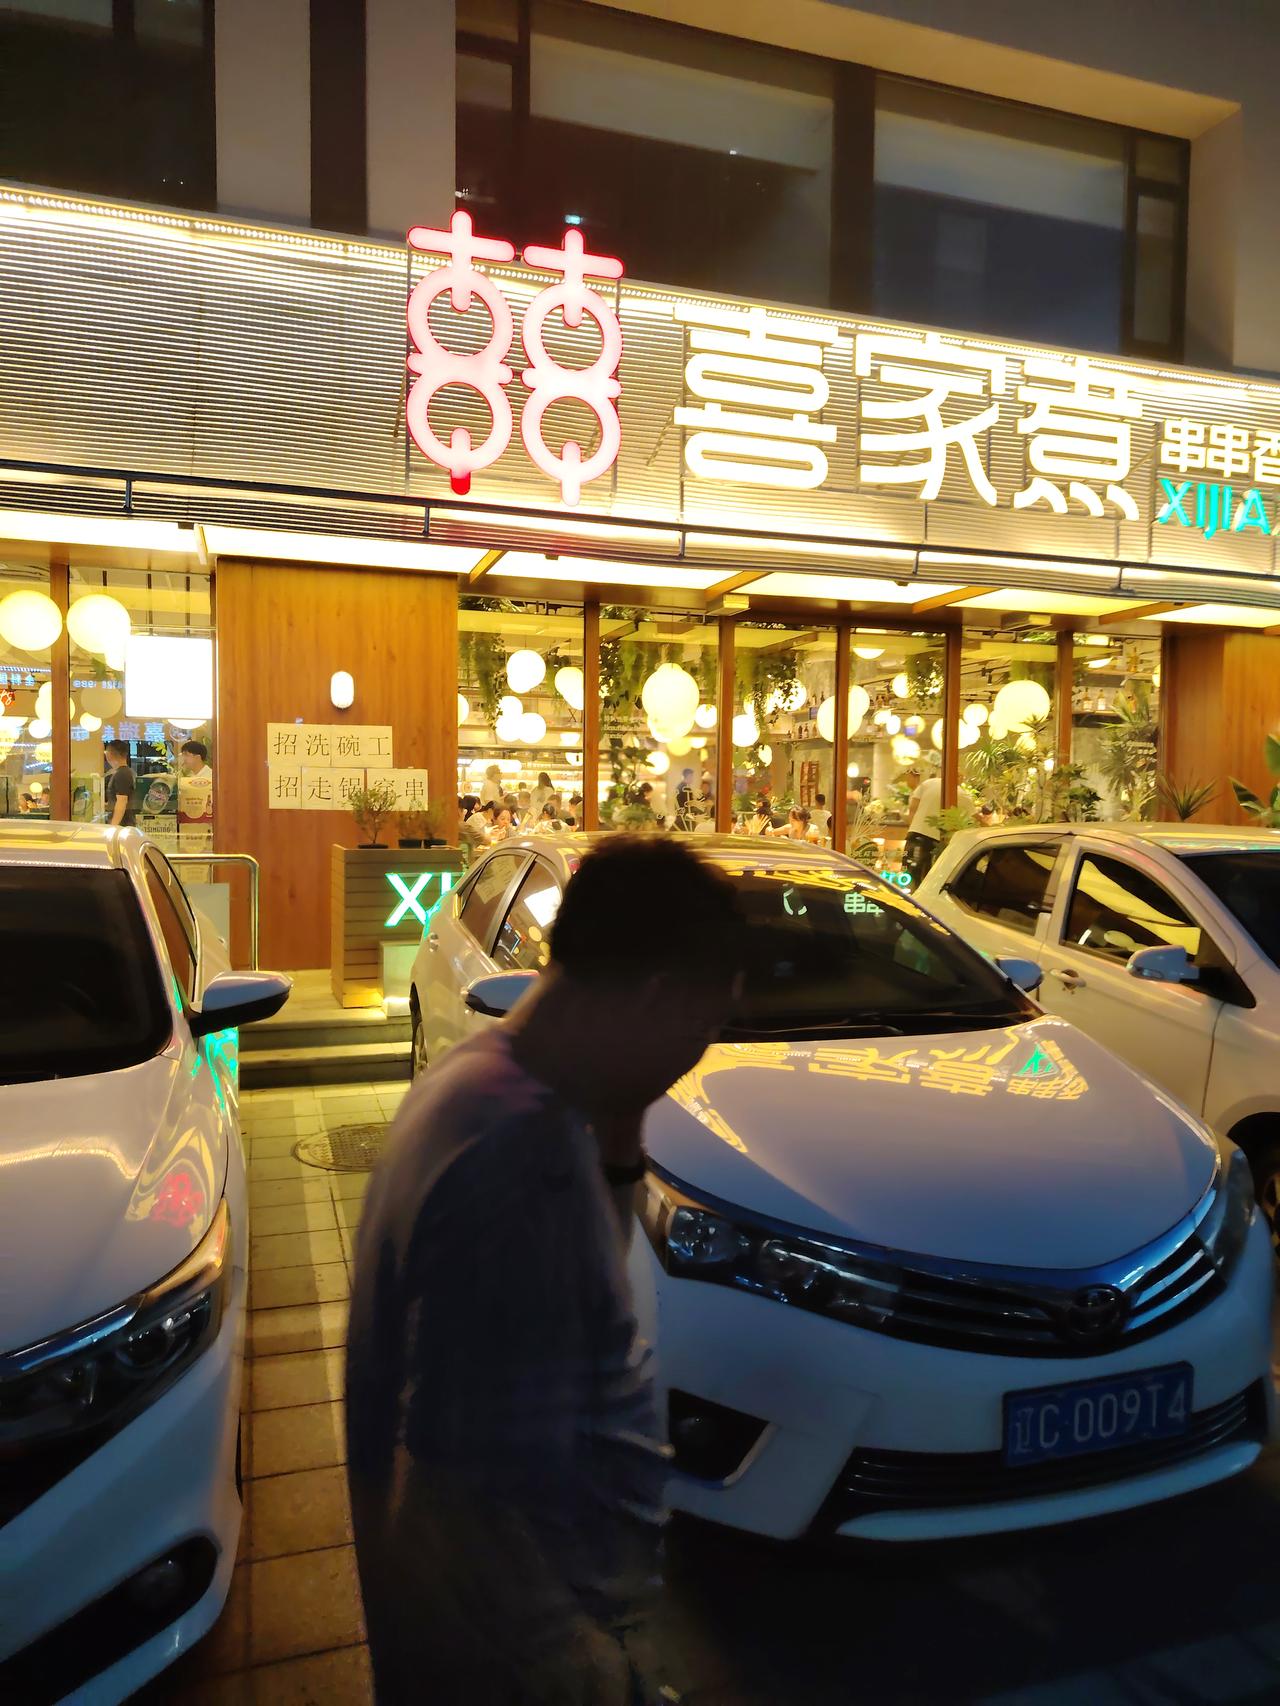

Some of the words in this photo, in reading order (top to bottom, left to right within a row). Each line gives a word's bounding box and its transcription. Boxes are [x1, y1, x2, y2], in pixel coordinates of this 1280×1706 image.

[673, 303, 1143, 521] 喜家煮
[273, 732, 391, 757] 招洗碗工
